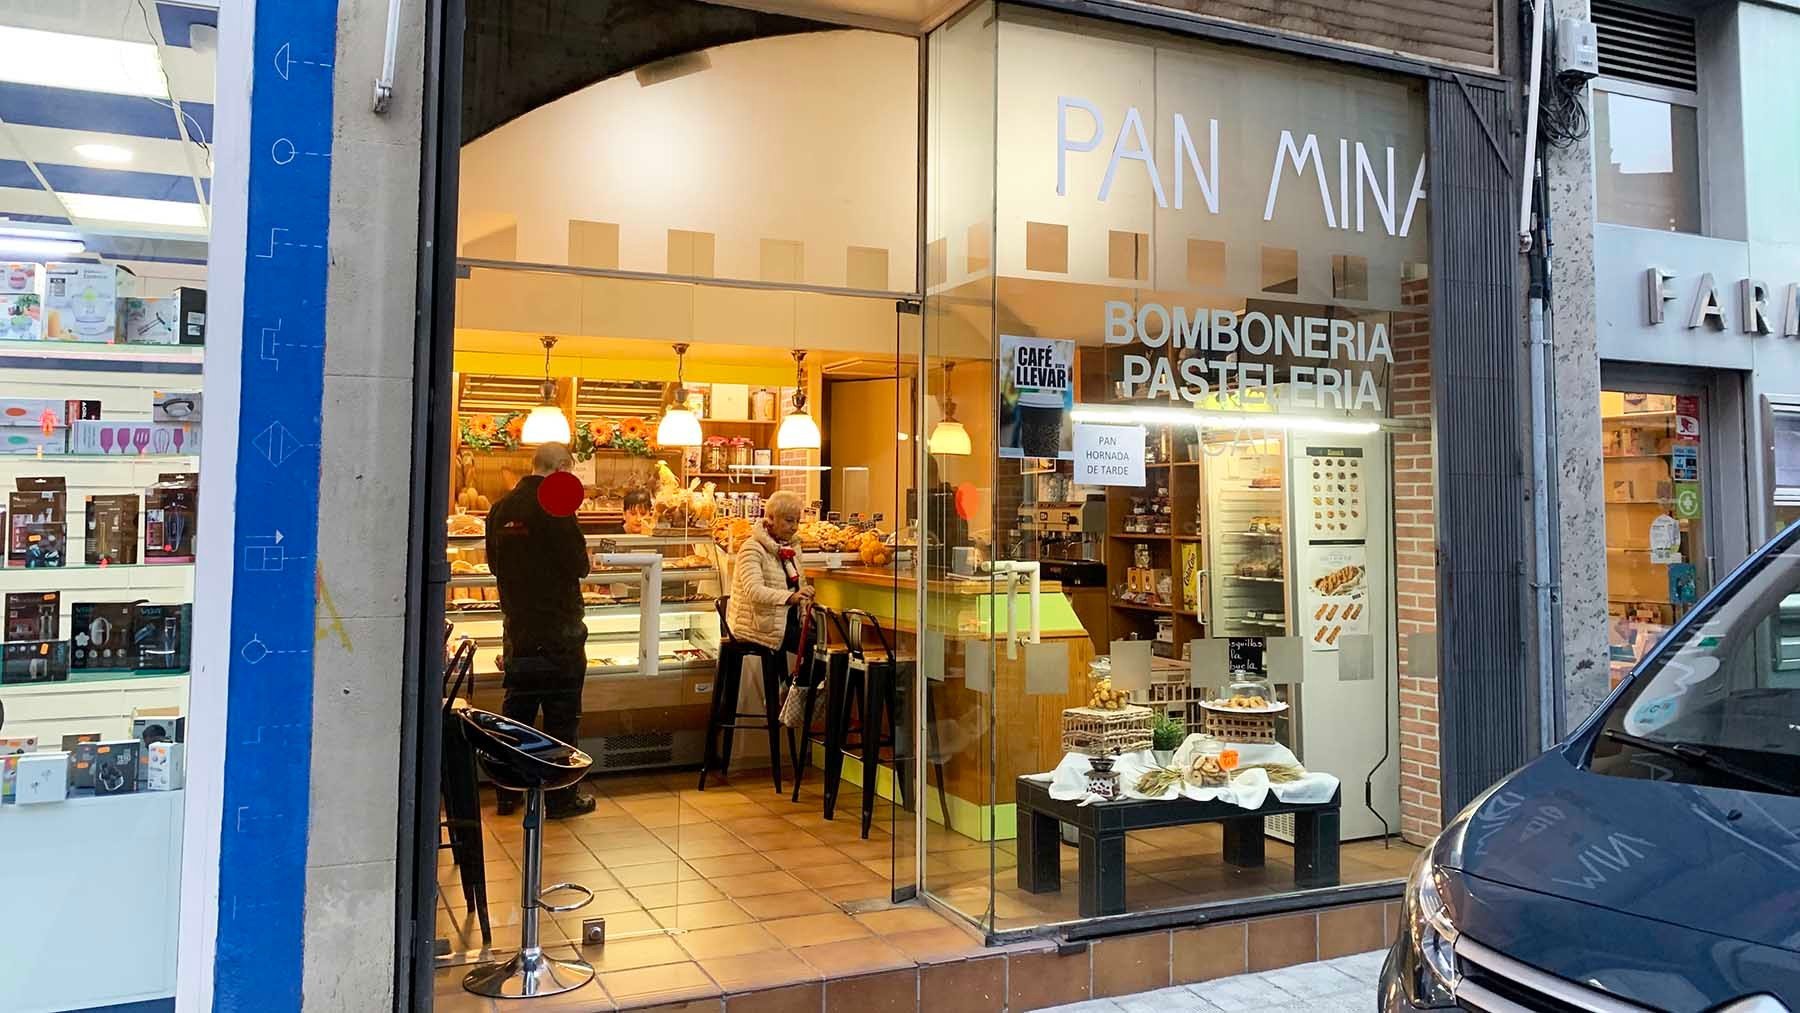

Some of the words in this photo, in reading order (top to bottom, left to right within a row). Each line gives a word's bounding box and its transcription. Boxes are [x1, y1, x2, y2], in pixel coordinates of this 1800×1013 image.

[1056, 95, 1219, 214] PAN
[1645, 266, 1800, 338] FAR
[1104, 301, 1394, 363] BOMBONERIA
[1018, 345, 1052, 368] CAFÉ
[1016, 366, 1066, 388] LLEVAR
[1123, 355, 1382, 412] PASTELERIA
[1098, 436, 1117, 446] PAN
[1086, 450, 1129, 461] HORNADA
[1087, 465, 1098, 474] DE
[1101, 465, 1129, 476] TARDE
[1230, 638, 1263, 650] squillas
[1230, 659, 1258, 670] buela
